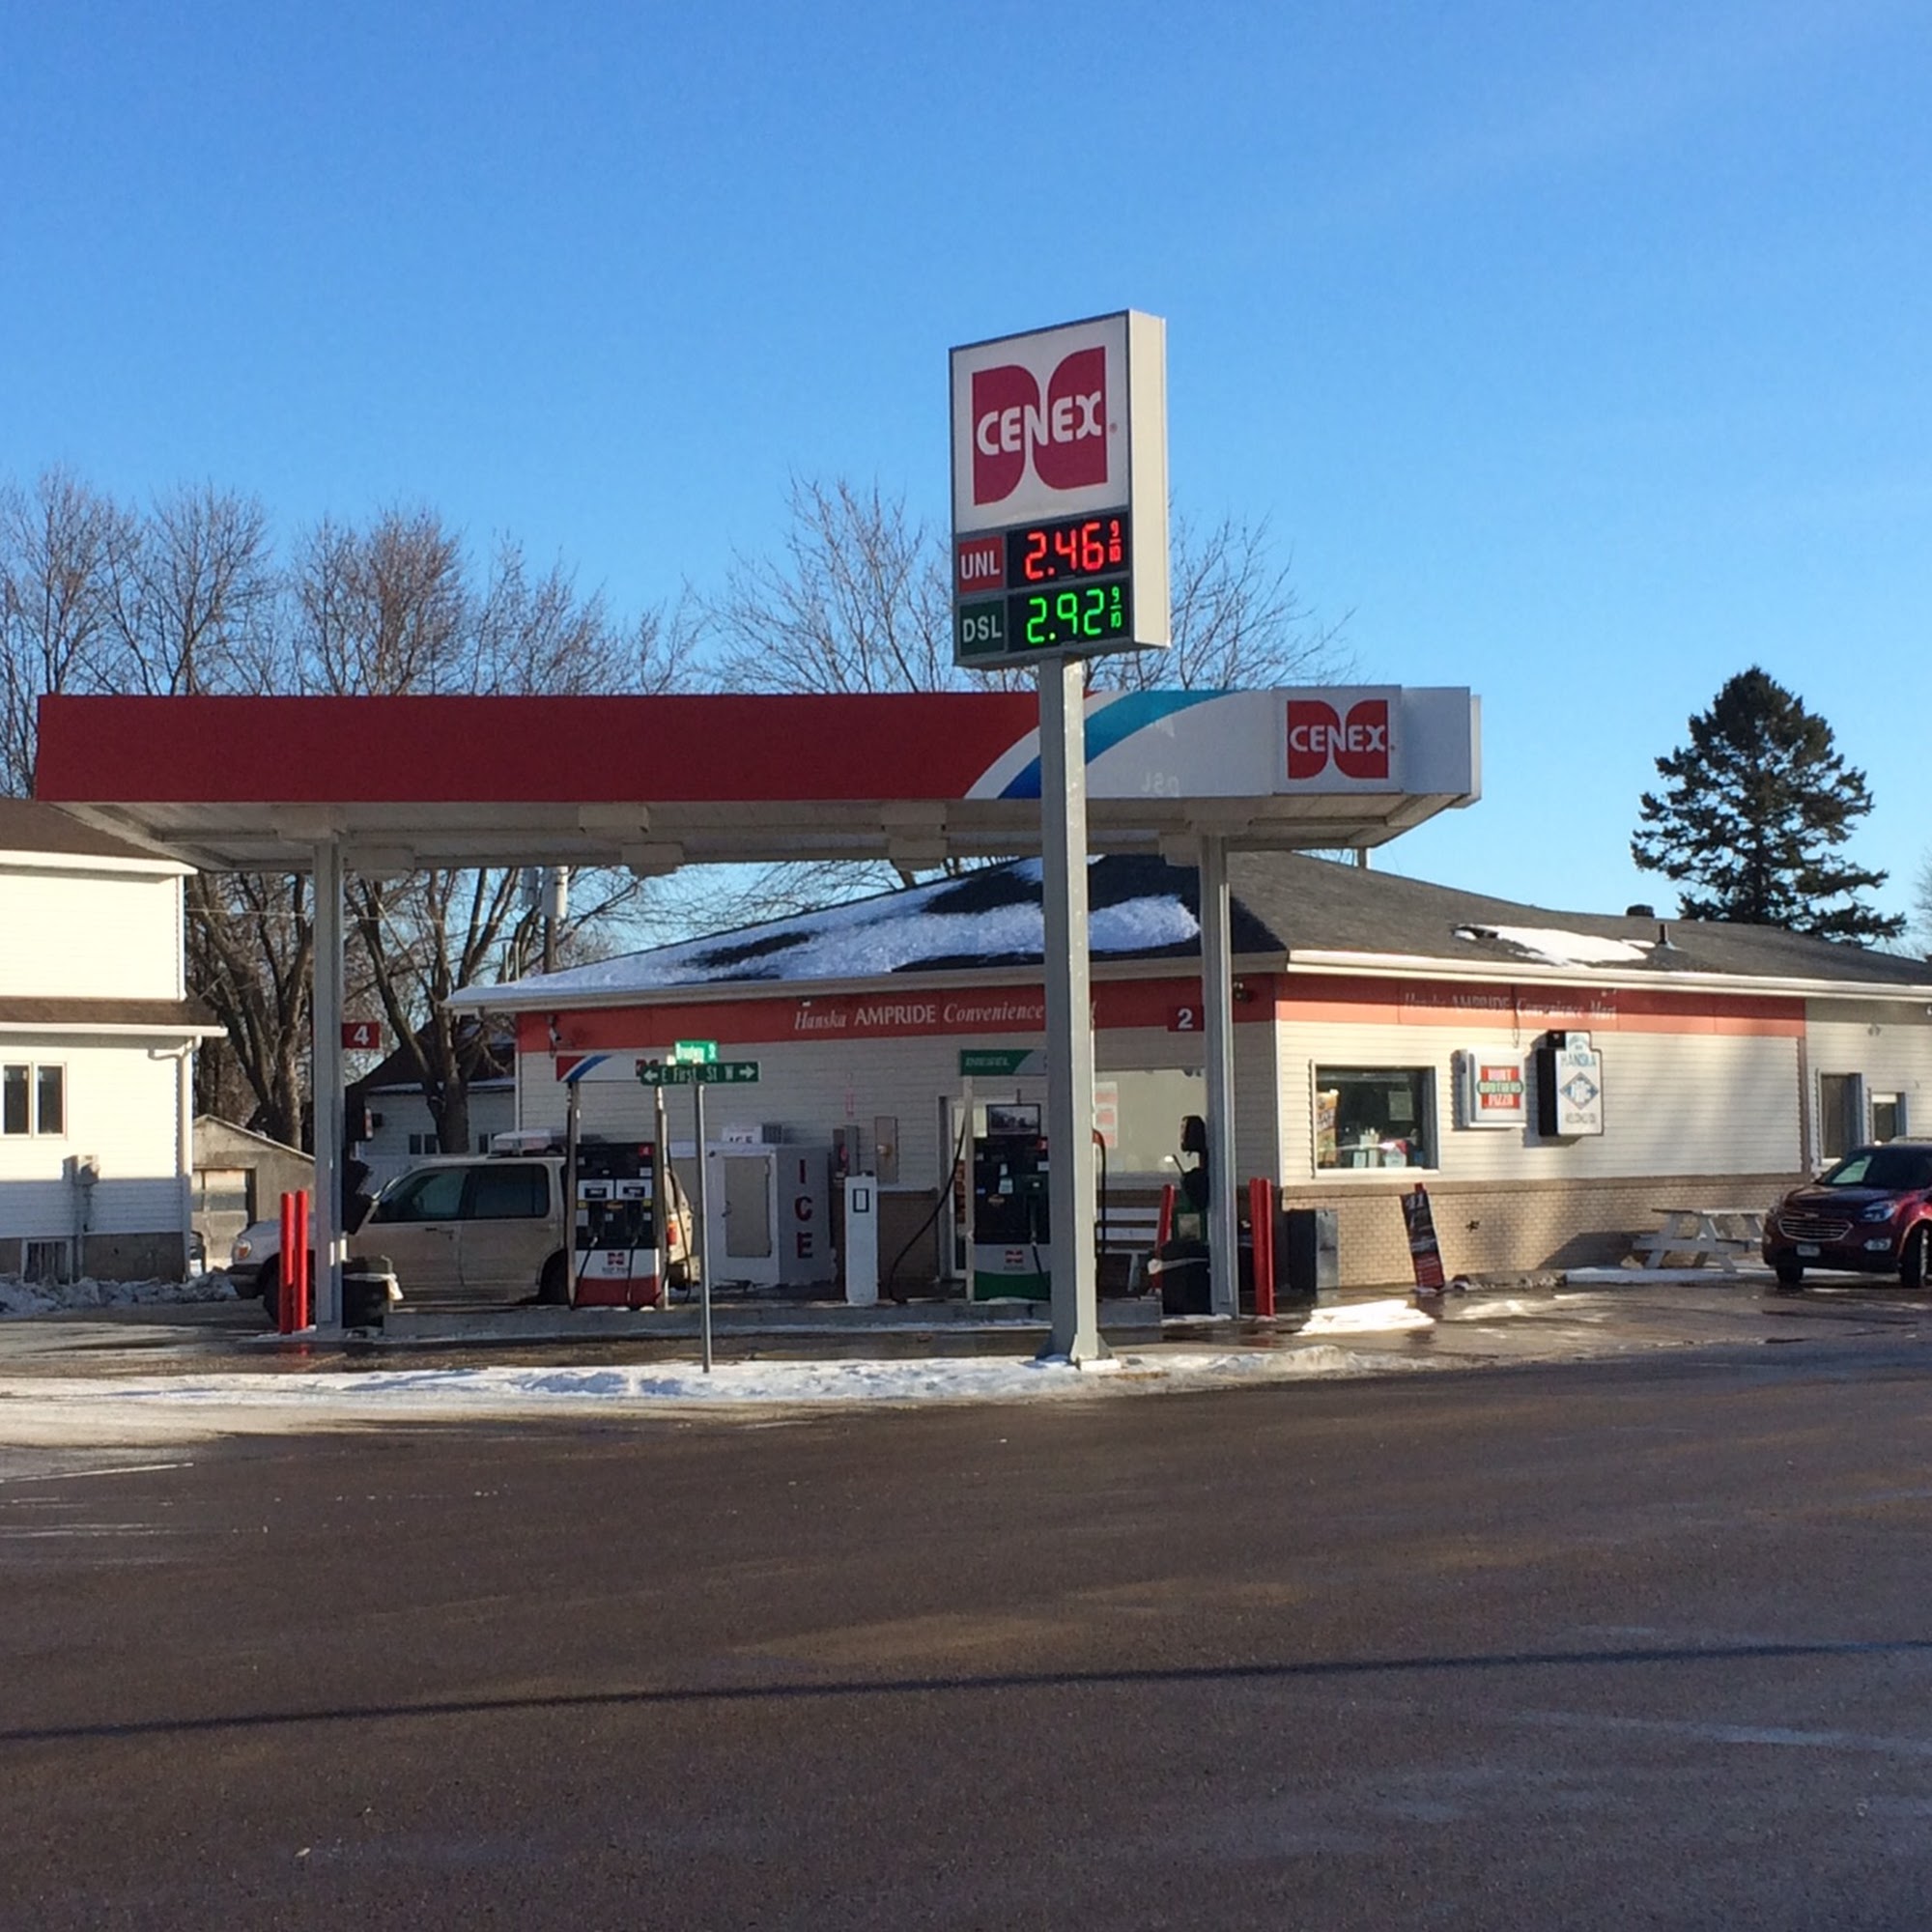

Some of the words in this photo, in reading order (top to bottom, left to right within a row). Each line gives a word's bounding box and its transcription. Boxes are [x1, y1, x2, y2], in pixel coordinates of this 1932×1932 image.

[976, 390, 1102, 456] CENEX
[961, 551, 1001, 580] UNL
[1025, 523, 1104, 581] 2.46
[963, 614, 1002, 643] DSL
[1027, 588, 1105, 644] 2.92
[1290, 724, 1385, 753] CENEX
[794, 1010, 846, 1030] Hanska
[854, 1005, 936, 1026] AMPRIDE
[943, 1002, 1044, 1024] Convenience
[1178, 1008, 1193, 1029] 2
[1516, 998, 1584, 1018] Convenience
[1589, 1000, 1617, 1020] Mart
[354, 1025, 369, 1045] 4
[661, 1066, 668, 1082] E
[672, 1065, 696, 1082] First
[706, 1065, 718, 1081] St
[795, 1159, 813, 1259] ICE
